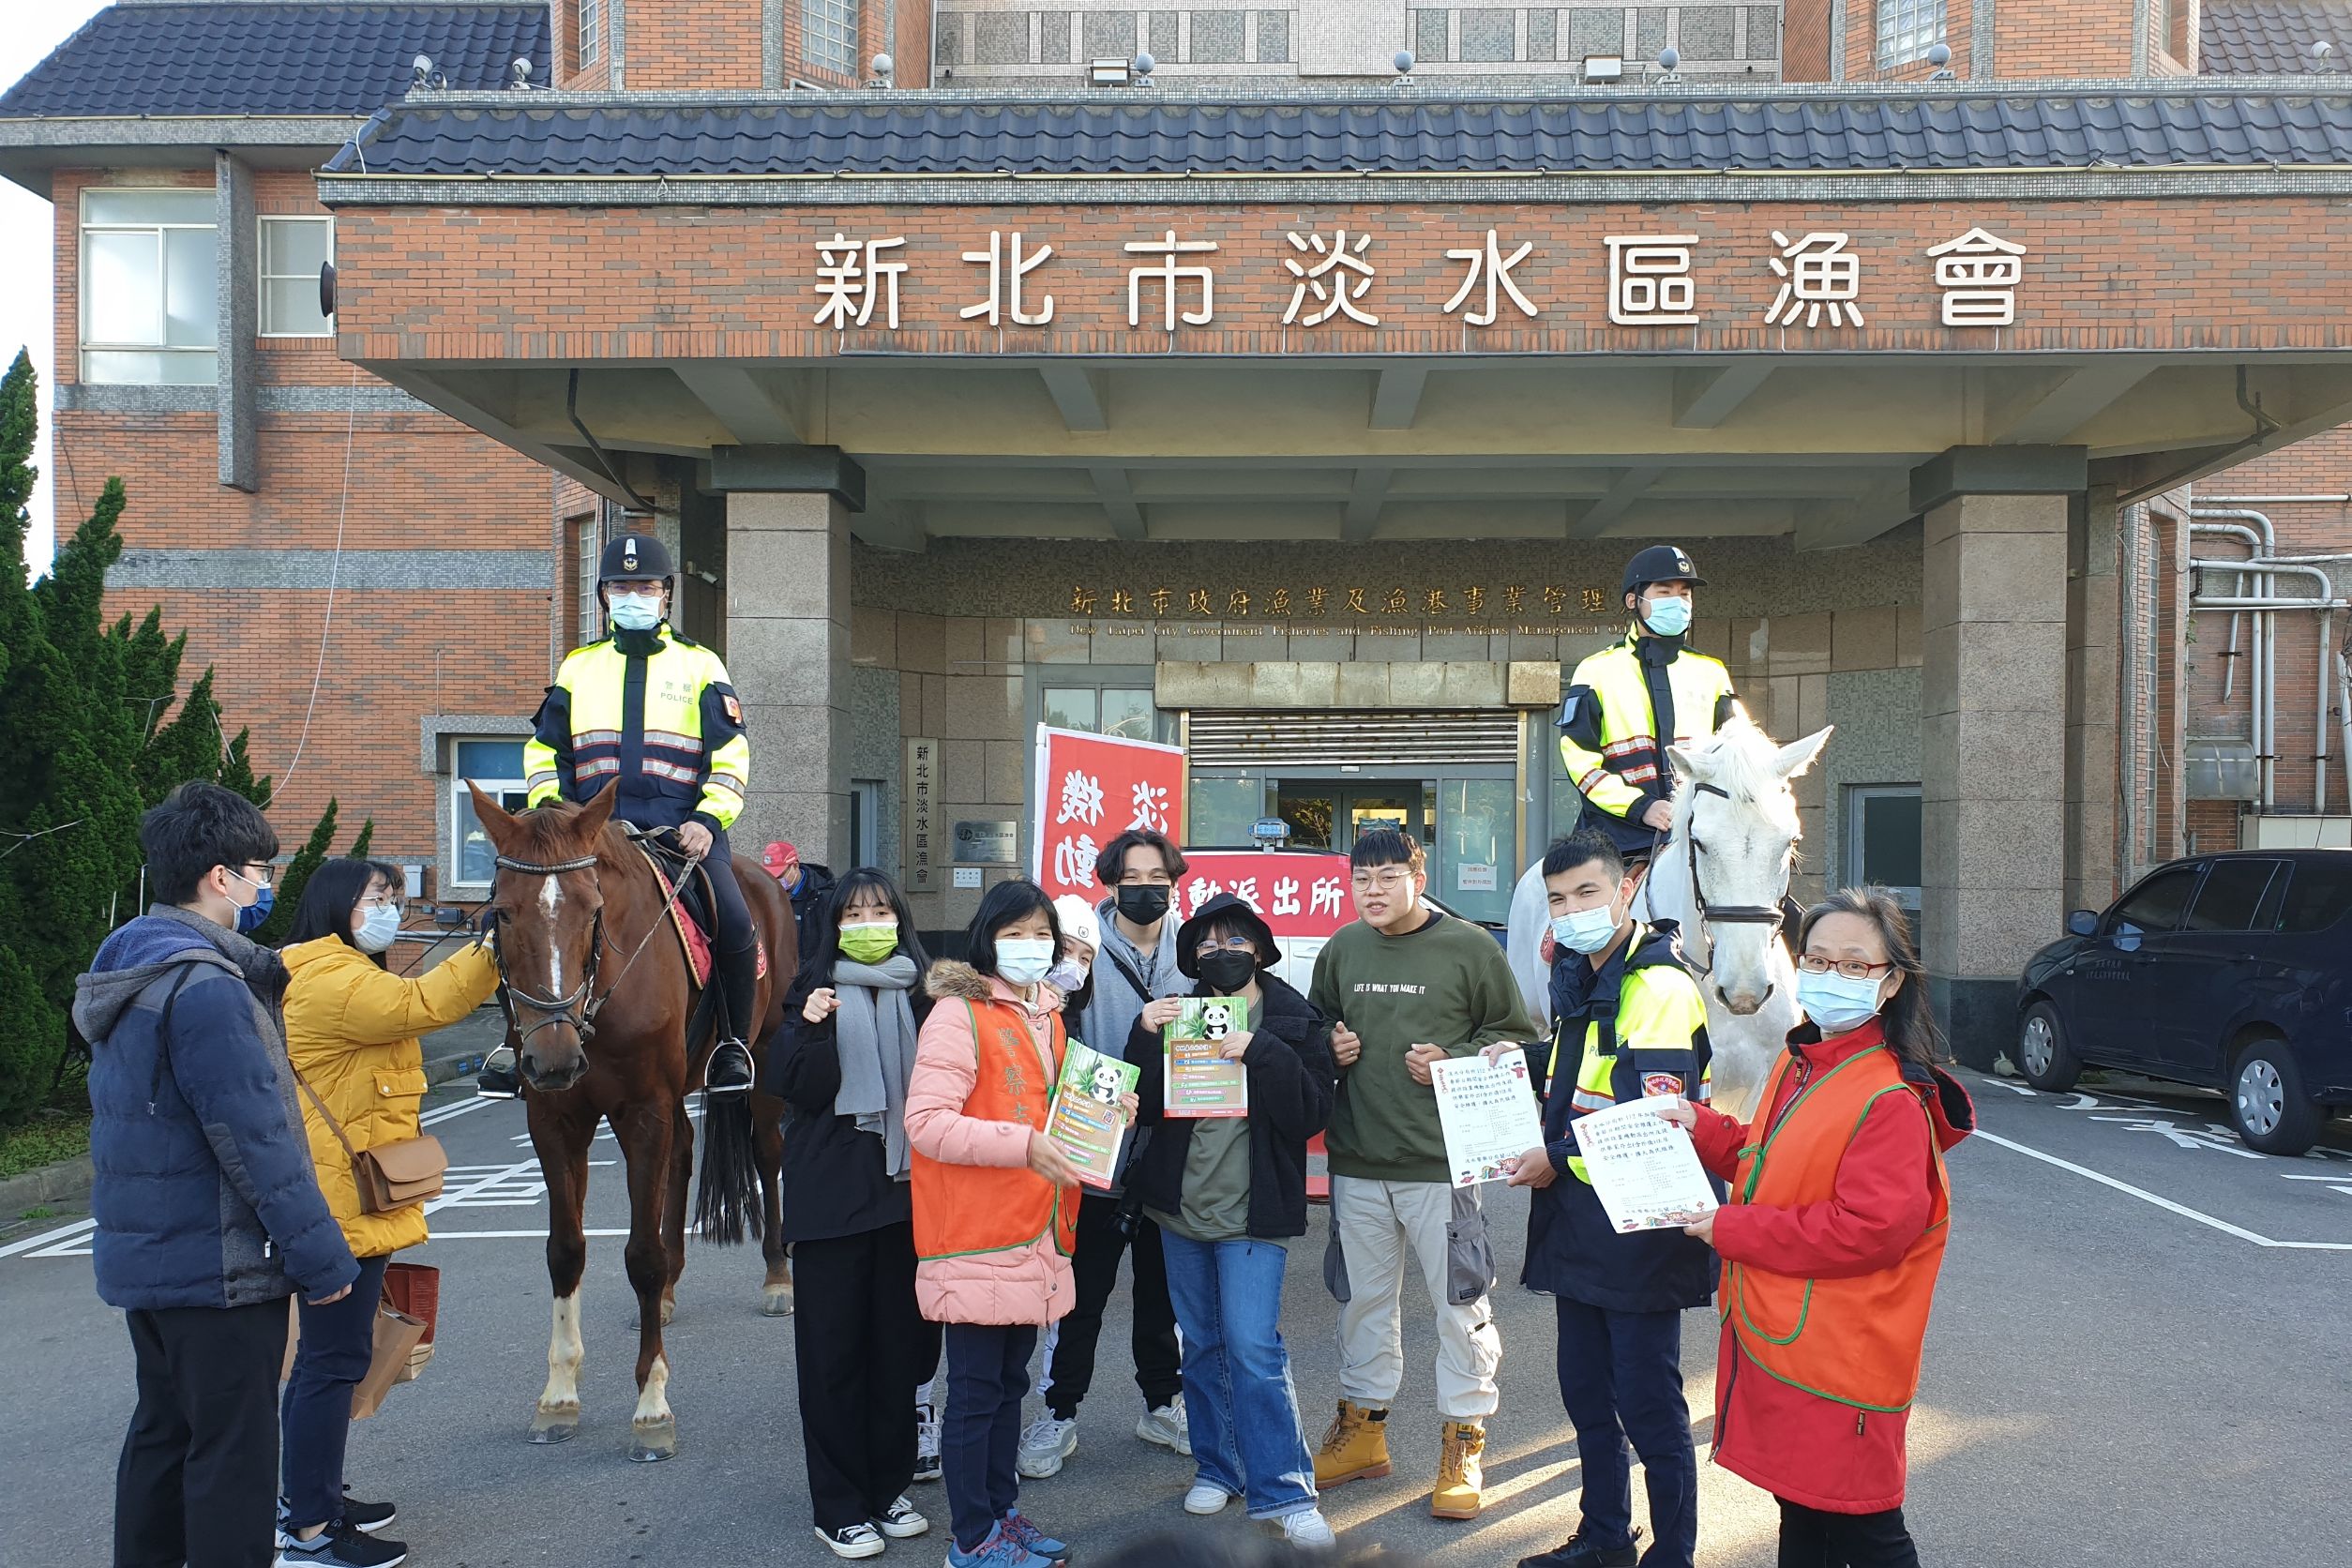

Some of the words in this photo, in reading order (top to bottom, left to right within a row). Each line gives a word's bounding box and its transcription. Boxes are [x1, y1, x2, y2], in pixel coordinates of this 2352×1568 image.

[812, 227, 2027, 331] 新北市淡水區漁會
[1069, 585, 1633, 616] 新北市政府漁業及漁港事業管理
[1070, 625, 1097, 636] New
[1108, 625, 1145, 638] Taipei
[1153, 625, 1179, 638] City
[1187, 625, 1264, 637] Government
[1273, 625, 1330, 637] Fisheries
[1337, 626, 1360, 636] and
[1370, 626, 1418, 638] Fishing
[1428, 626, 1454, 636] Port
[1463, 626, 1508, 636] Affairs
[1517, 625, 1600, 637] Management
[660, 692, 694, 705] POLICE
[915, 746, 929, 884] 新北市淡水區漁會
[1353, 983, 1364, 992] LIFE
[1365, 983, 1370, 992] IS
[1372, 983, 1388, 993] WHAT
[1390, 984, 1399, 994] YOU
[1400, 984, 1417, 994] MAKE
[1419, 986, 1425, 995] IT
